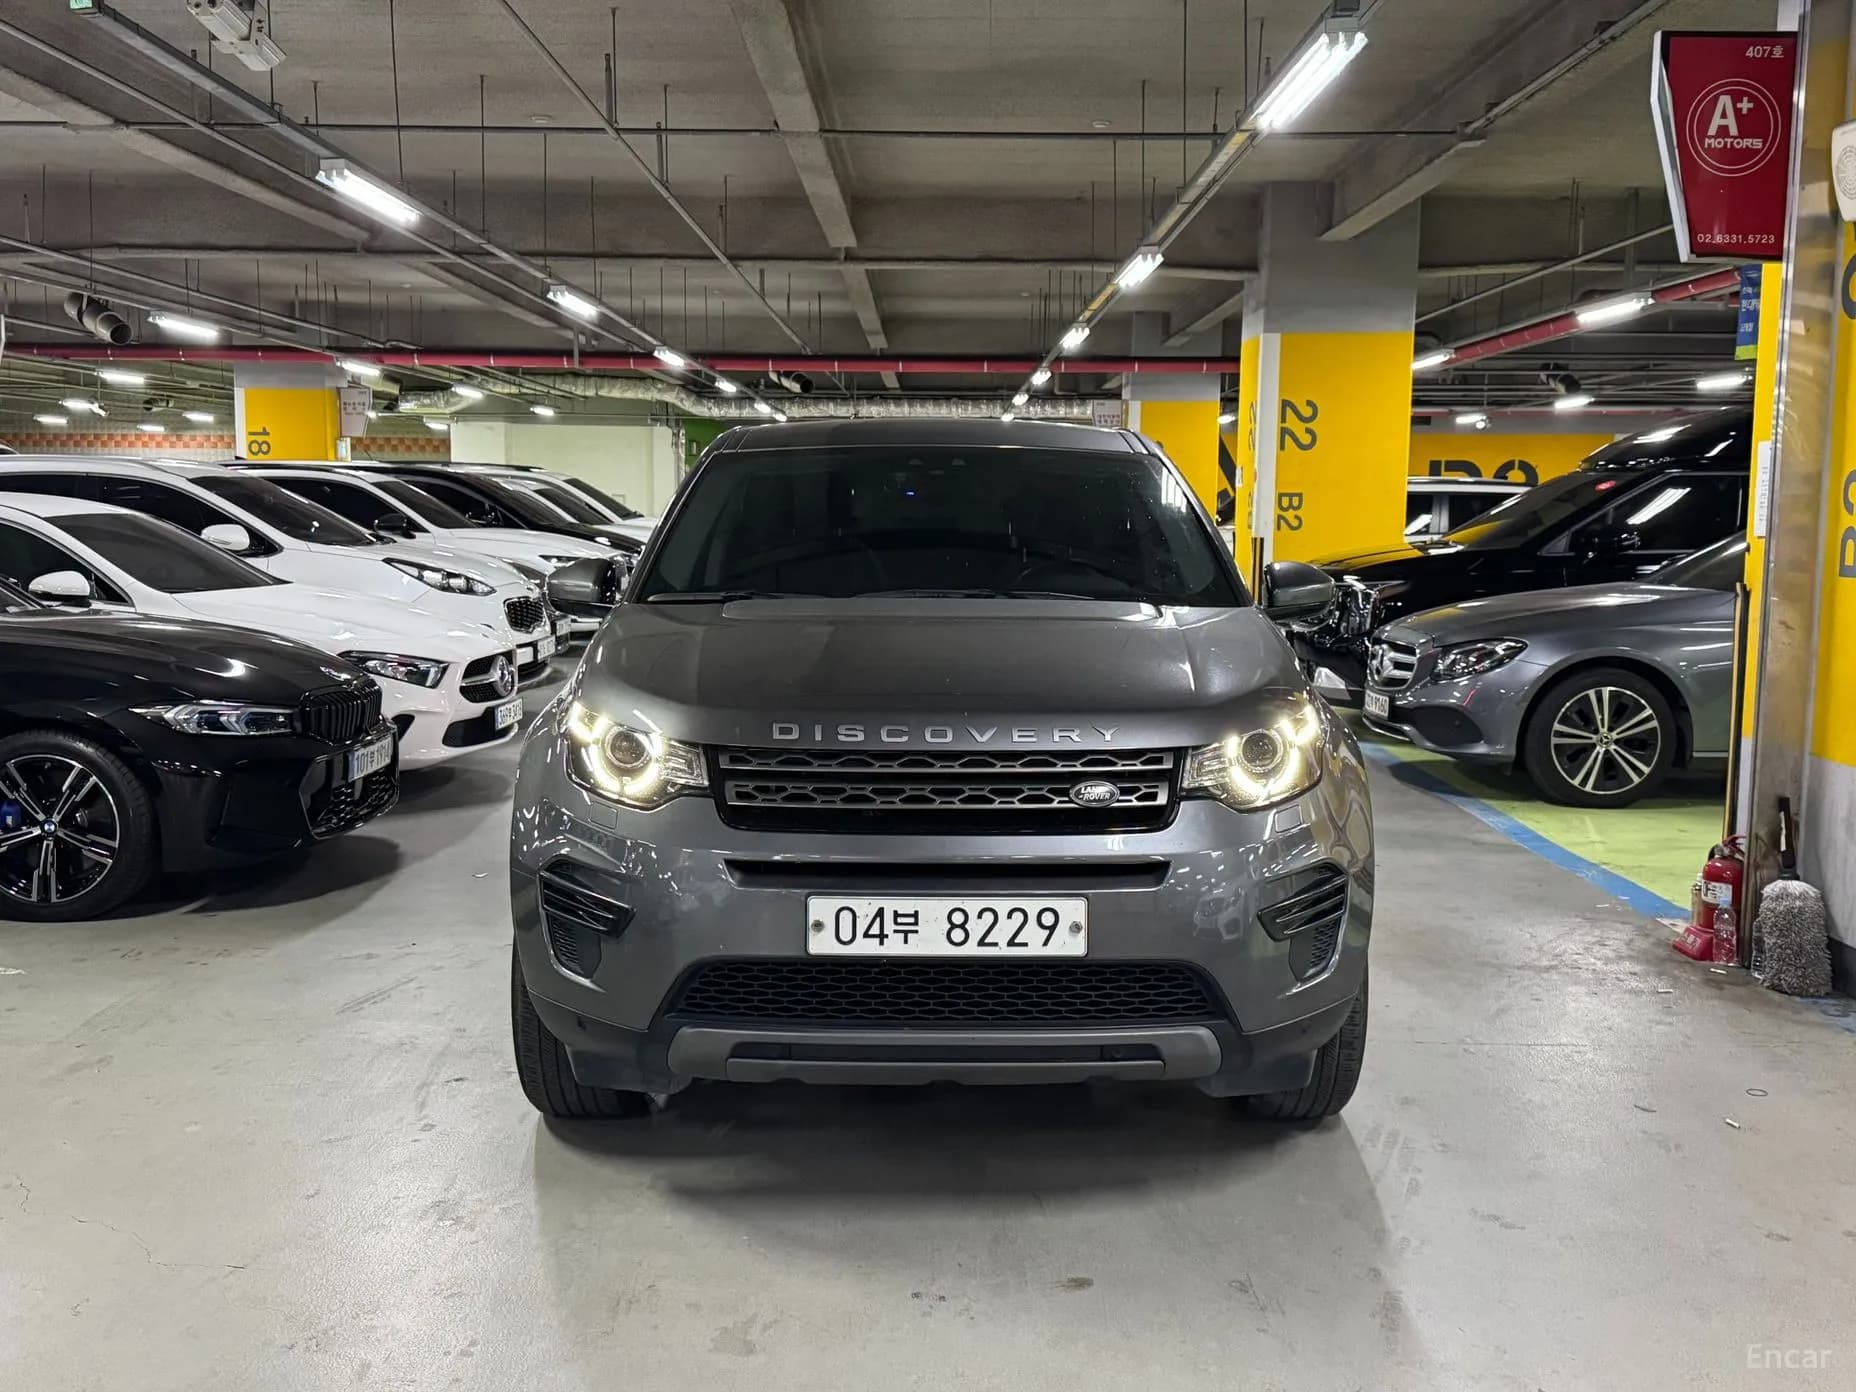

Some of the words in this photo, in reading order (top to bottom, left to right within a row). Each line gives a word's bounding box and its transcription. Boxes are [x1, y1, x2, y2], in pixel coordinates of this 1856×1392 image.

[1745, 45, 1784, 58] 407호
[1707, 94, 1754, 136] A+
[1704, 138, 1762, 149] MOTORS
[1696, 233, 1775, 244] 02.6331.5723
[1280, 398, 1318, 451] 22
[248, 426, 271, 455] 18
[1277, 492, 1303, 531] B2
[772, 722, 1120, 743] DISCOVERY
[1083, 793, 1111, 801] ROVER
[834, 906, 920, 946] 04부
[946, 906, 1060, 947] 8229
